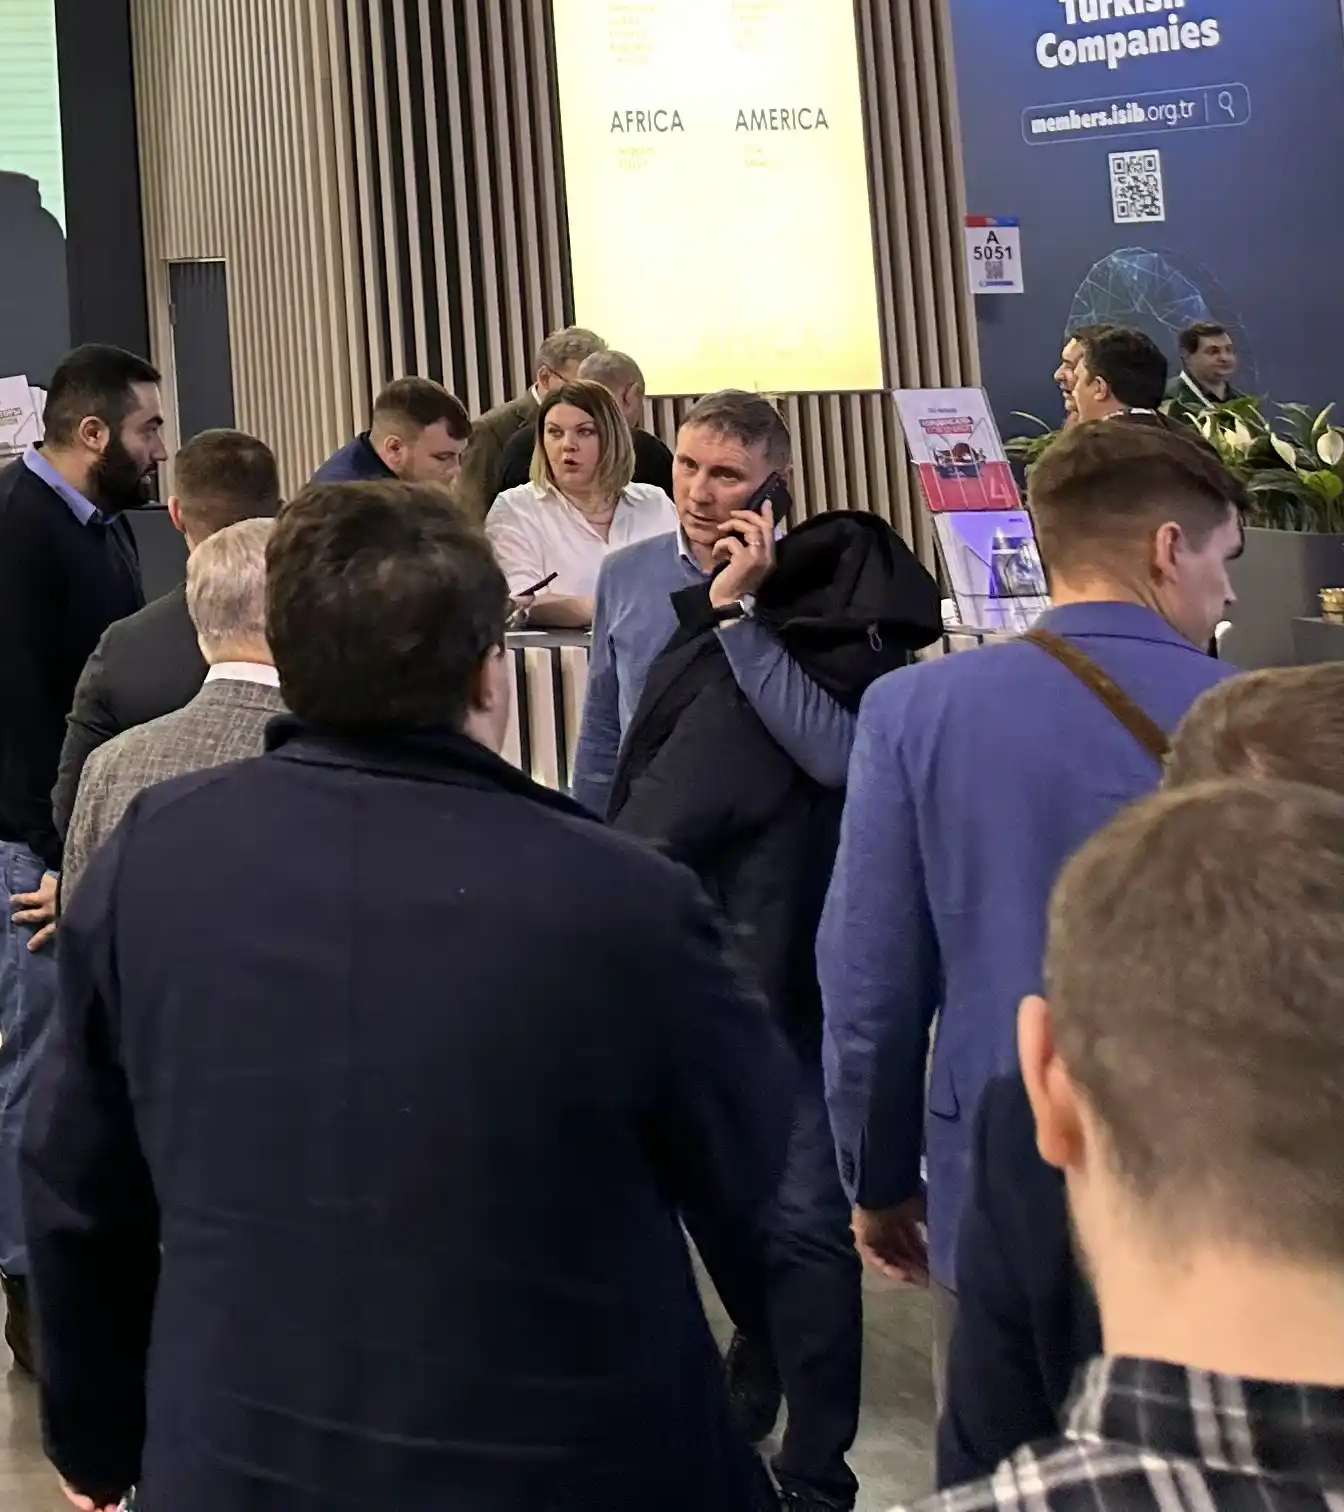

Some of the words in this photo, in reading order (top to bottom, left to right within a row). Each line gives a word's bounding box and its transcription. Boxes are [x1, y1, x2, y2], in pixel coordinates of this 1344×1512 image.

[1035, 13, 1221, 70] Companies
[610, 109, 685, 133] AFRICA
[735, 107, 830, 131] AMERICA
[1030, 99, 1196, 135] members.isib.org.tr
[986, 229, 1000, 245] A
[973, 245, 1013, 261] 5051
